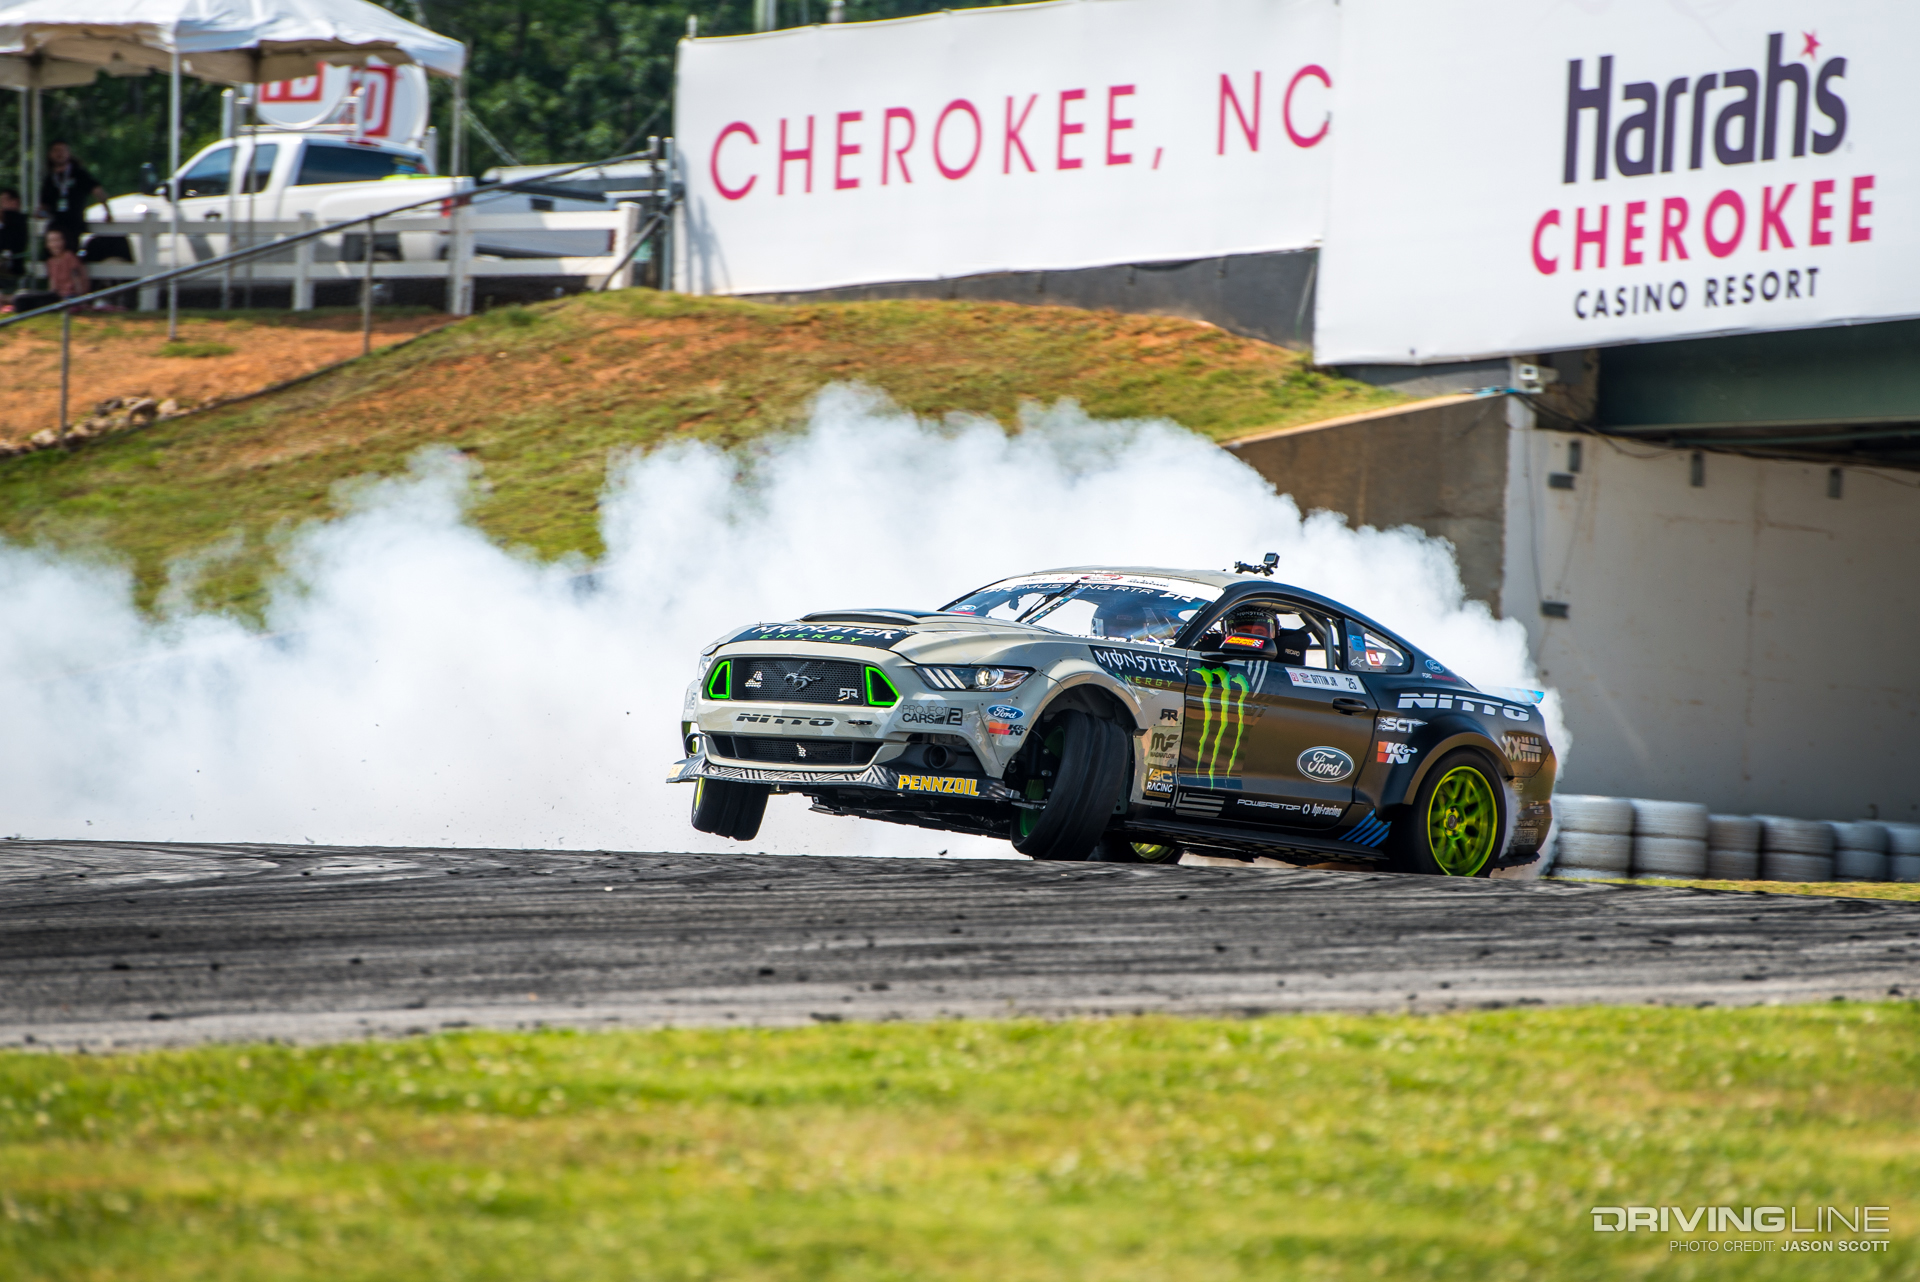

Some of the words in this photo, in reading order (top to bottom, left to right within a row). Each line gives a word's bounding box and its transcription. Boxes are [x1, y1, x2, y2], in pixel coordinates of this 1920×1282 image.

[709, 83, 1165, 200] CHEROKEE,
[1217, 64, 1334, 155] NC
[1531, 175, 1876, 276] CHEROKEE
[1574, 280, 1688, 320] CASINO
[1704, 267, 1820, 308] RESORT
[1114, 586, 1155, 595] RTR
[751, 624, 900, 640] MONSTER
[758, 633, 863, 643] ENERGY
[1094, 649, 1184, 677] MONSTER
[902, 705, 949, 715] PROJECT
[1397, 693, 1530, 722] NITTO
[736, 713, 835, 726] NITTO
[902, 713, 935, 724] CARS
[950, 708, 963, 725] 2
[1385, 717, 1416, 734] SCT
[1386, 741, 1419, 764] K&N
[897, 774, 980, 797] PENNZOIL
[1146, 781, 1174, 793] RACING
[1237, 799, 1302, 811] POWERSTOP
